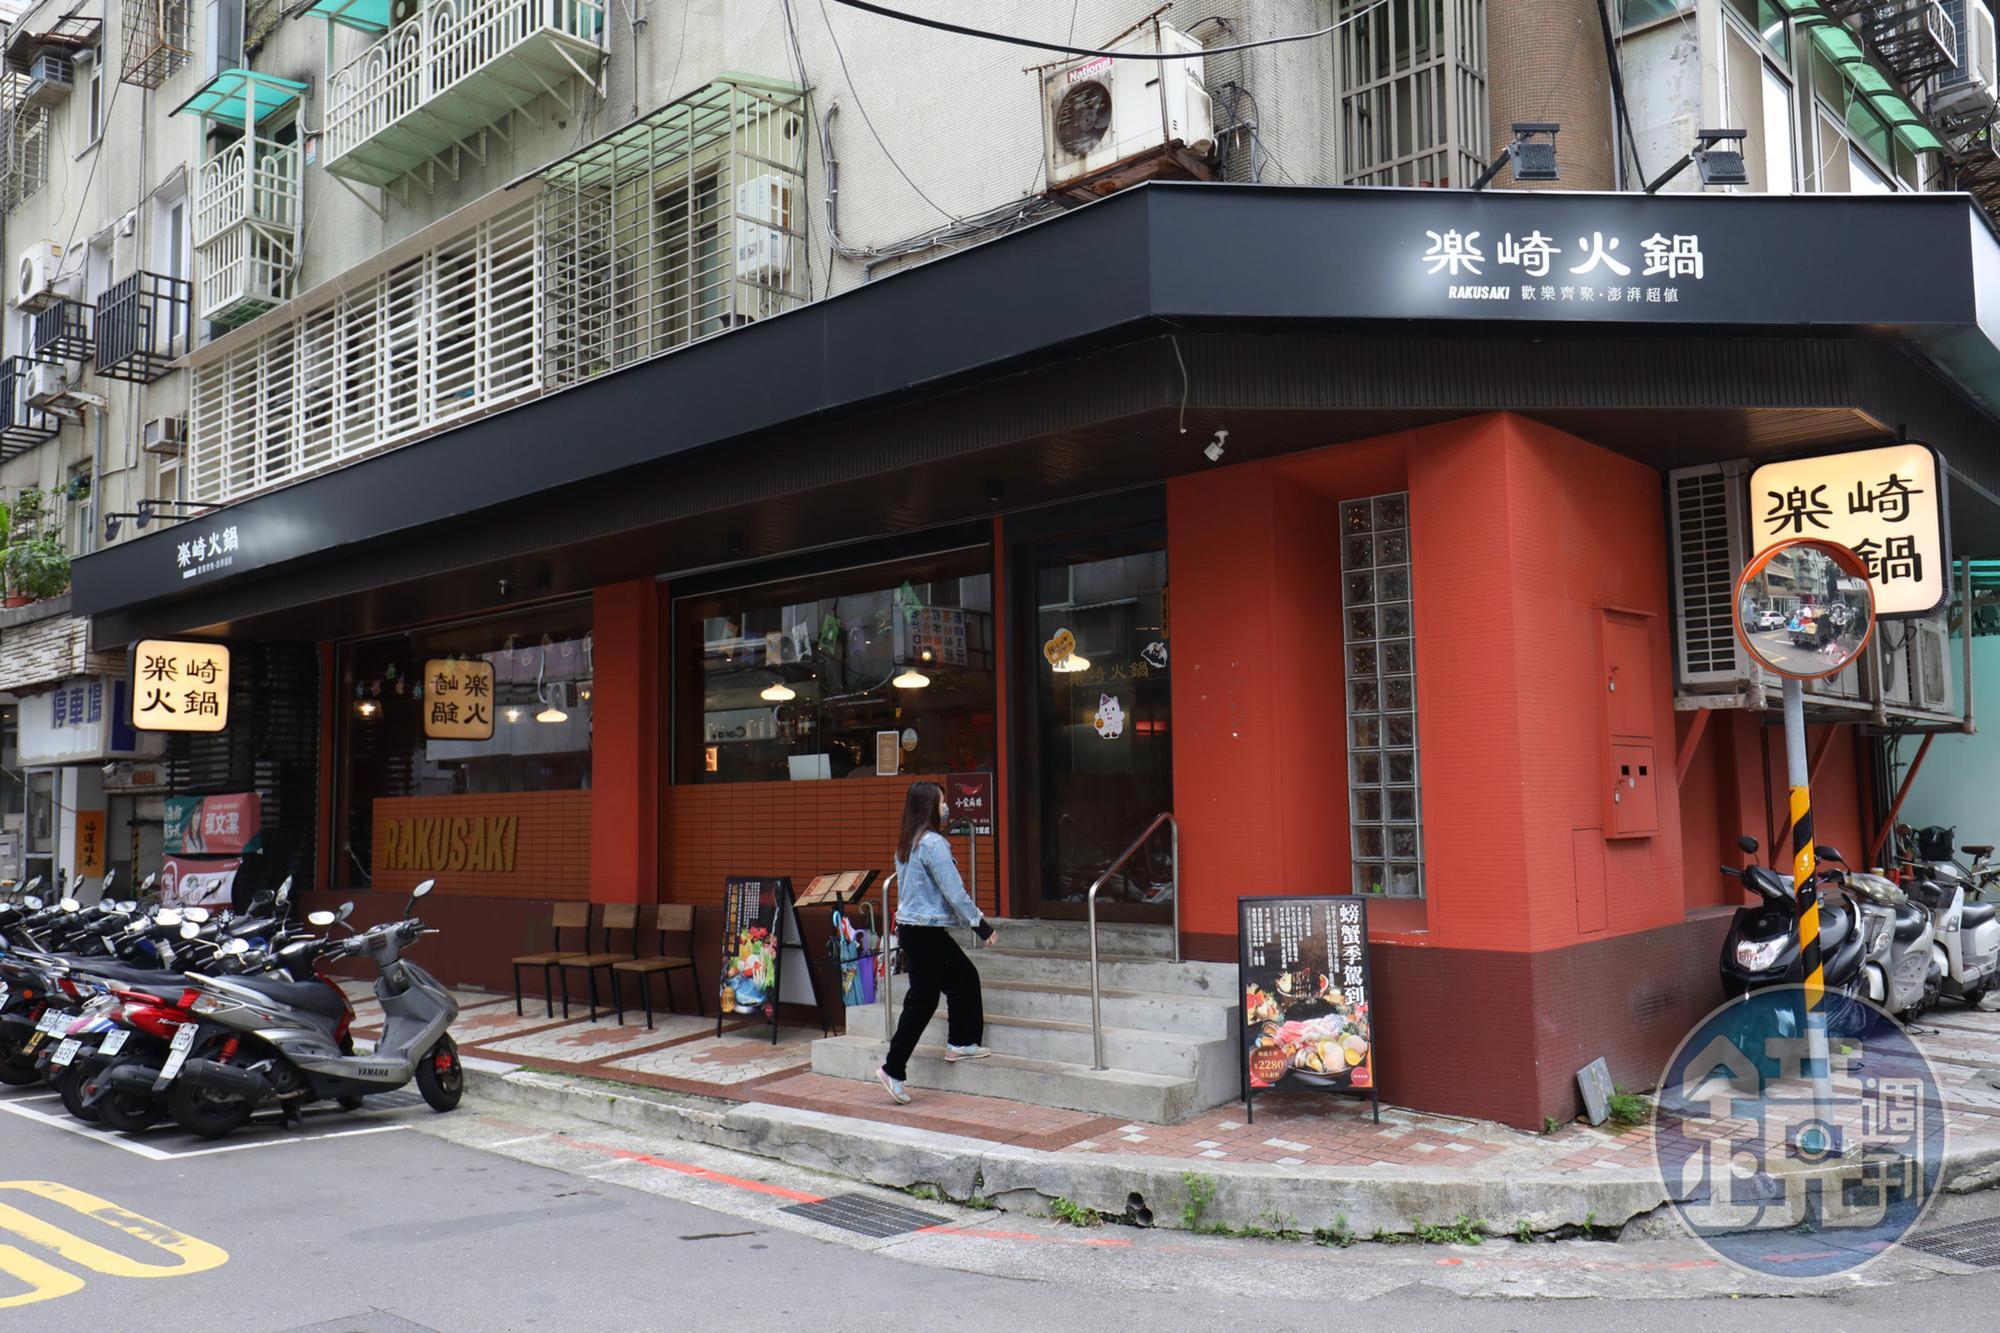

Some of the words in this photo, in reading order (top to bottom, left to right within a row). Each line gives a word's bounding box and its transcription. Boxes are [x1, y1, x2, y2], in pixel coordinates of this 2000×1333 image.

[1068, 58, 1112, 83] National
[1421, 228, 1704, 280] 楽崎火鍋
[1448, 286, 1510, 301] RAKUSAKI
[1850, 535, 1923, 585] 鍋
[385, 816, 519, 872] RAKUSAKI
[1339, 903, 1366, 1007] 螃蟹季駕到
[357, 1067, 389, 1078] YAMAHA
